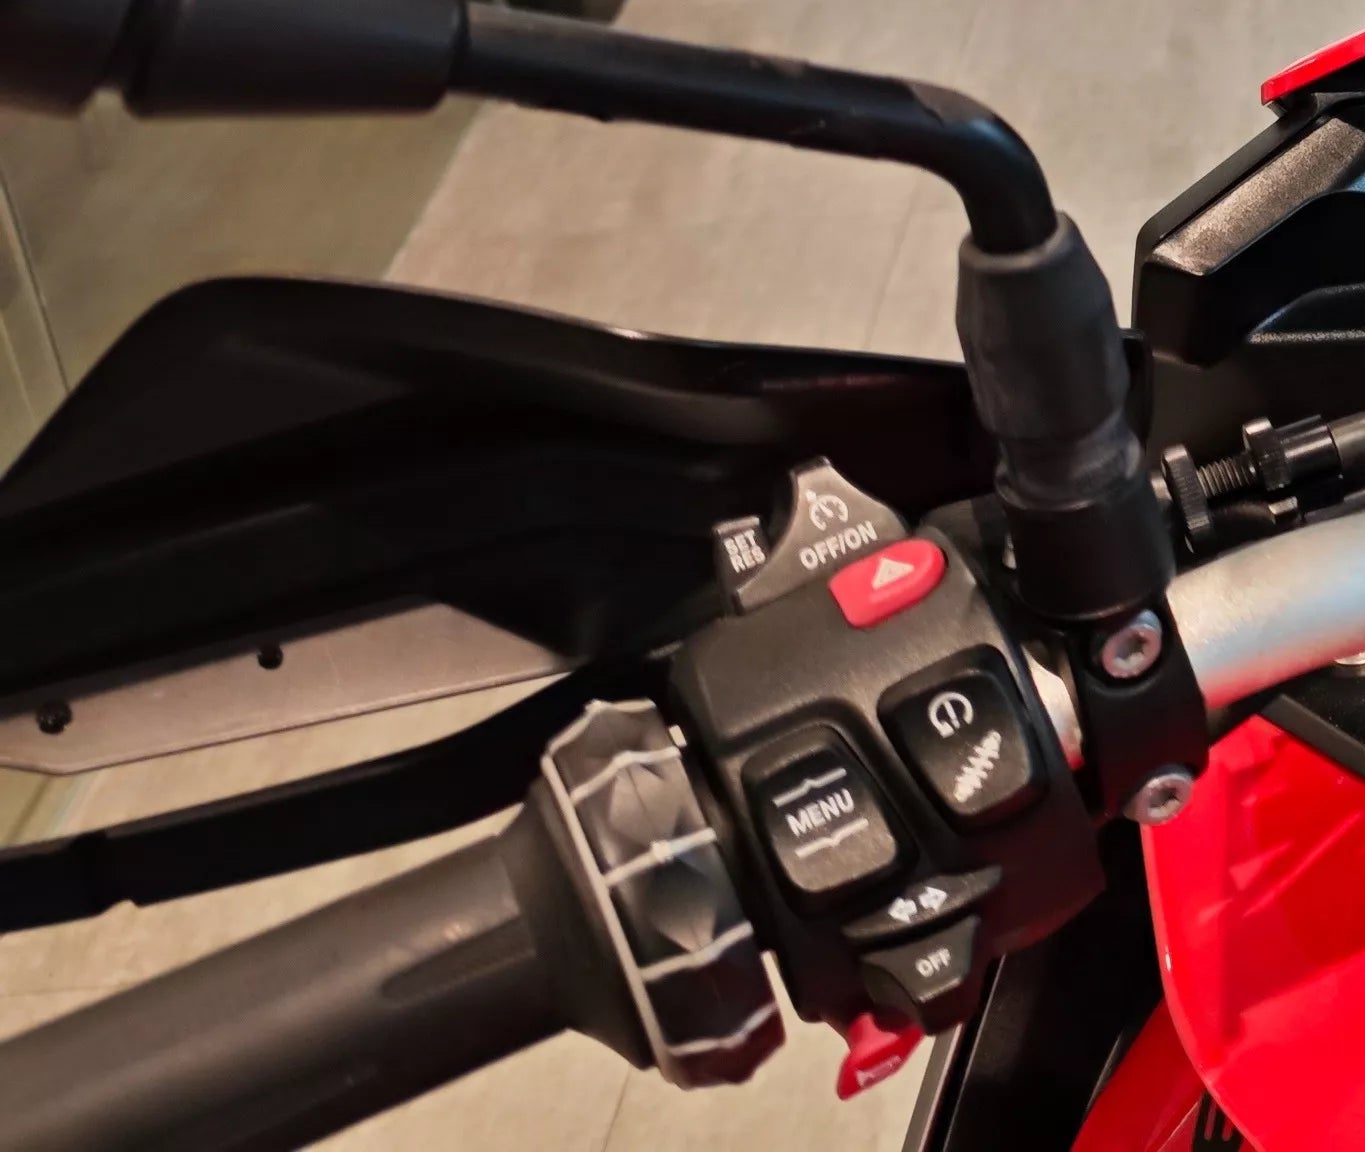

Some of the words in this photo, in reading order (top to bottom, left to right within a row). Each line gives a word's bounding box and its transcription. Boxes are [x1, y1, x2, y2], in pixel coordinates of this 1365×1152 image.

[723, 529, 755, 555] SET
[801, 520, 878, 570] OFF/ON
[730, 545, 766, 573] RES
[786, 788, 854, 837] MENU
[916, 948, 951, 977] OFF
